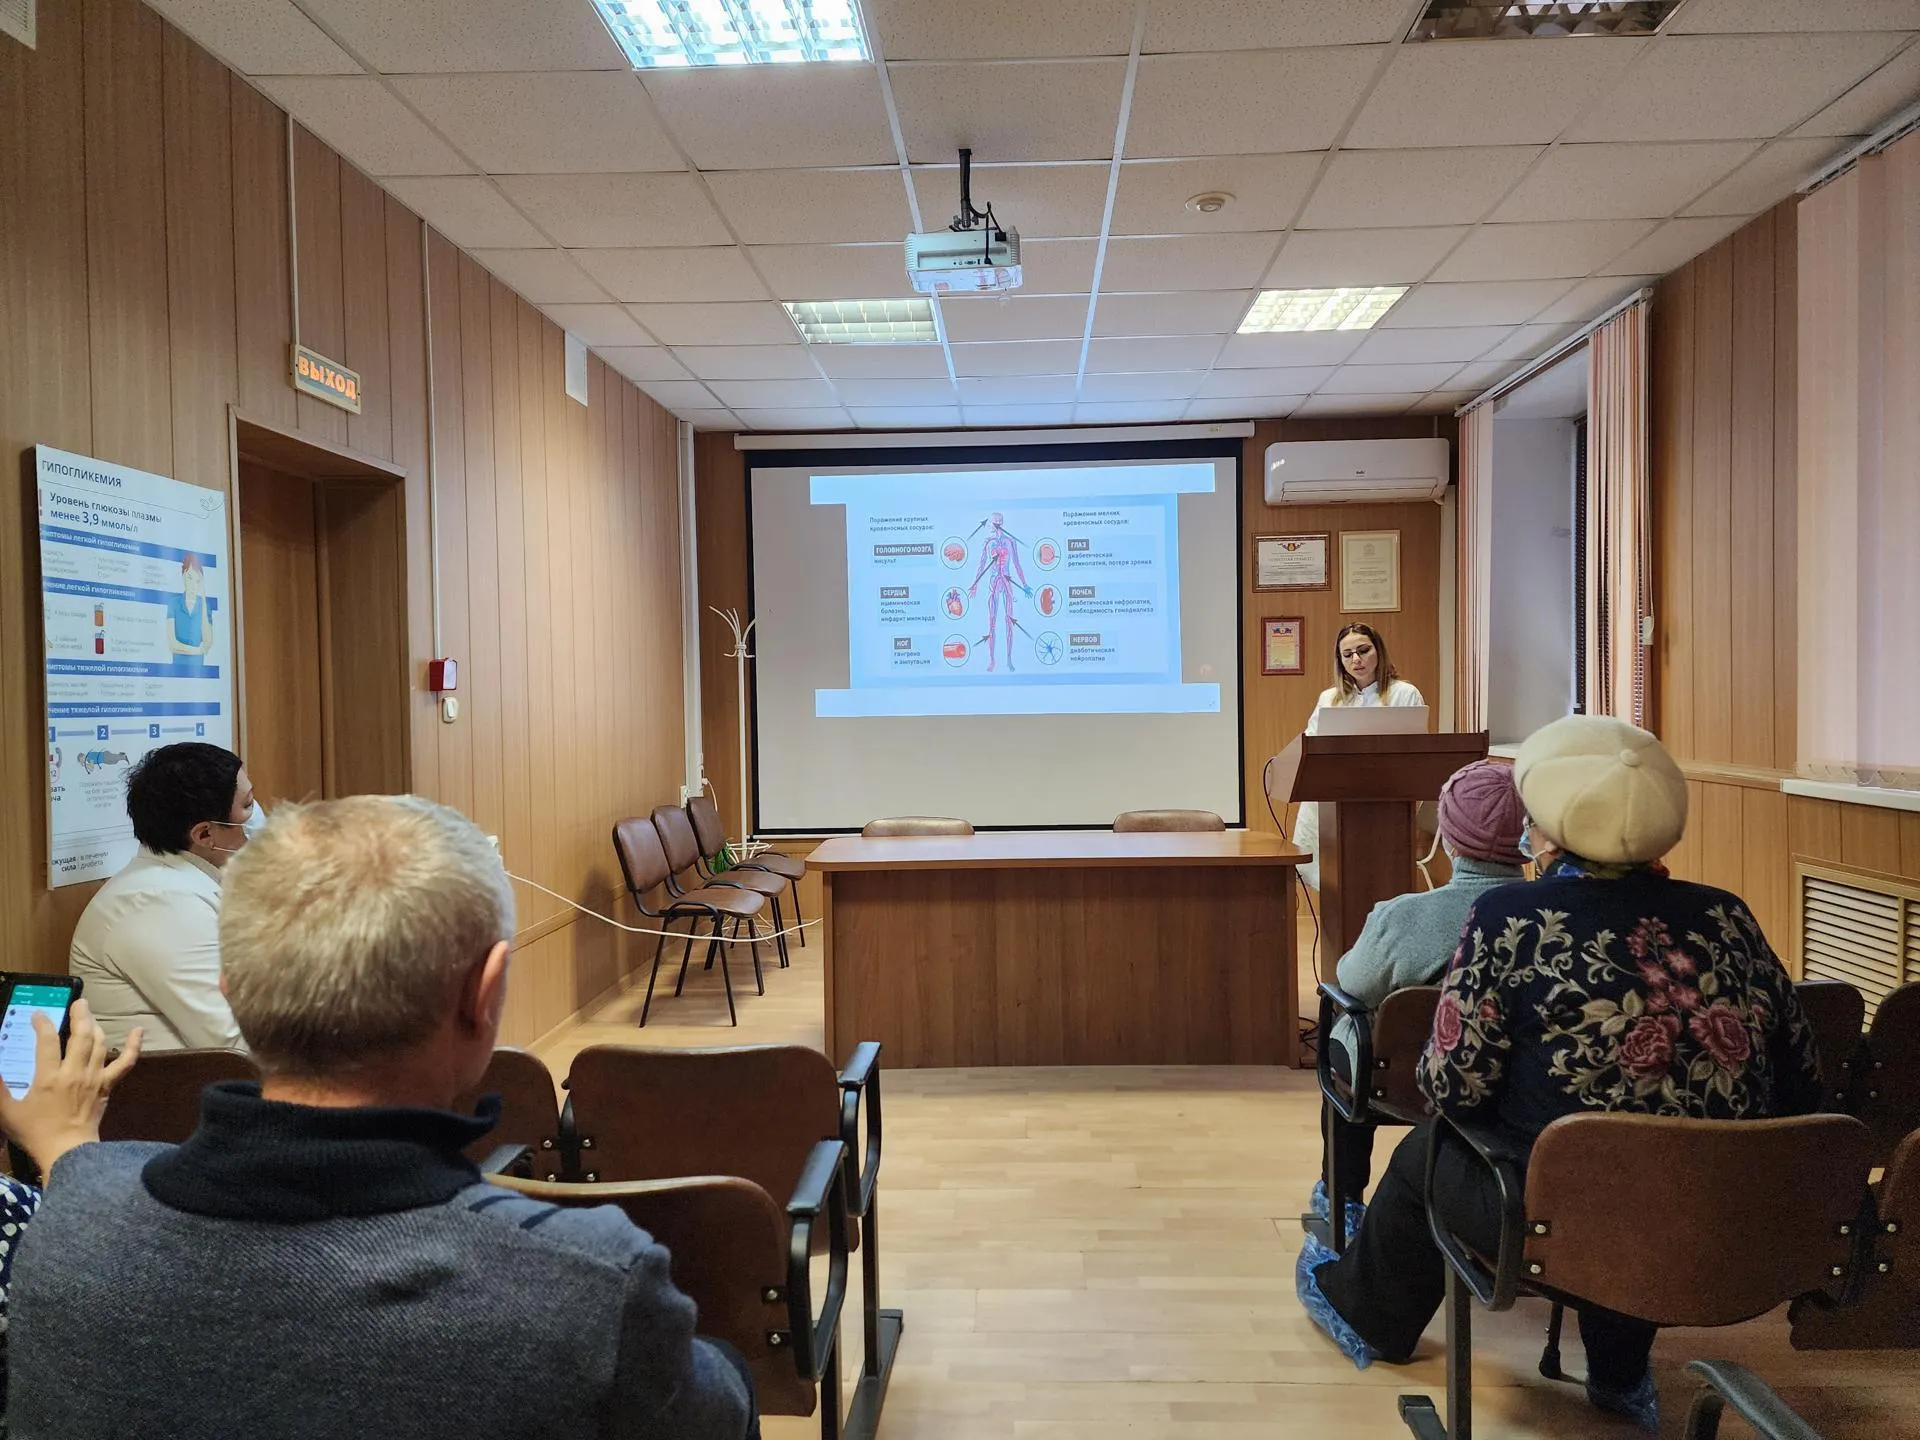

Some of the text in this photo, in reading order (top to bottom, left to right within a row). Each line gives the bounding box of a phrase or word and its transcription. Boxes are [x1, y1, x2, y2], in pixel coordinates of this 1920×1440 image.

[299, 356, 356, 400] ВЫХОД
[42, 460, 122, 488] ГИПОГЛИКЕМИЯ
[50, 492, 162, 523] Уровень глюкозы плазмы
[50, 510, 138, 533] менее 3,9 ммоль/л
[1070, 541, 1087, 549] ГЛАЗ
[1072, 588, 1093, 596] ПОЧЕК
[76, 664, 106, 672] тяжелой
[70, 706, 100, 714] тяжелой
[100, 727, 107, 738] 2
[151, 726, 157, 736] 3
